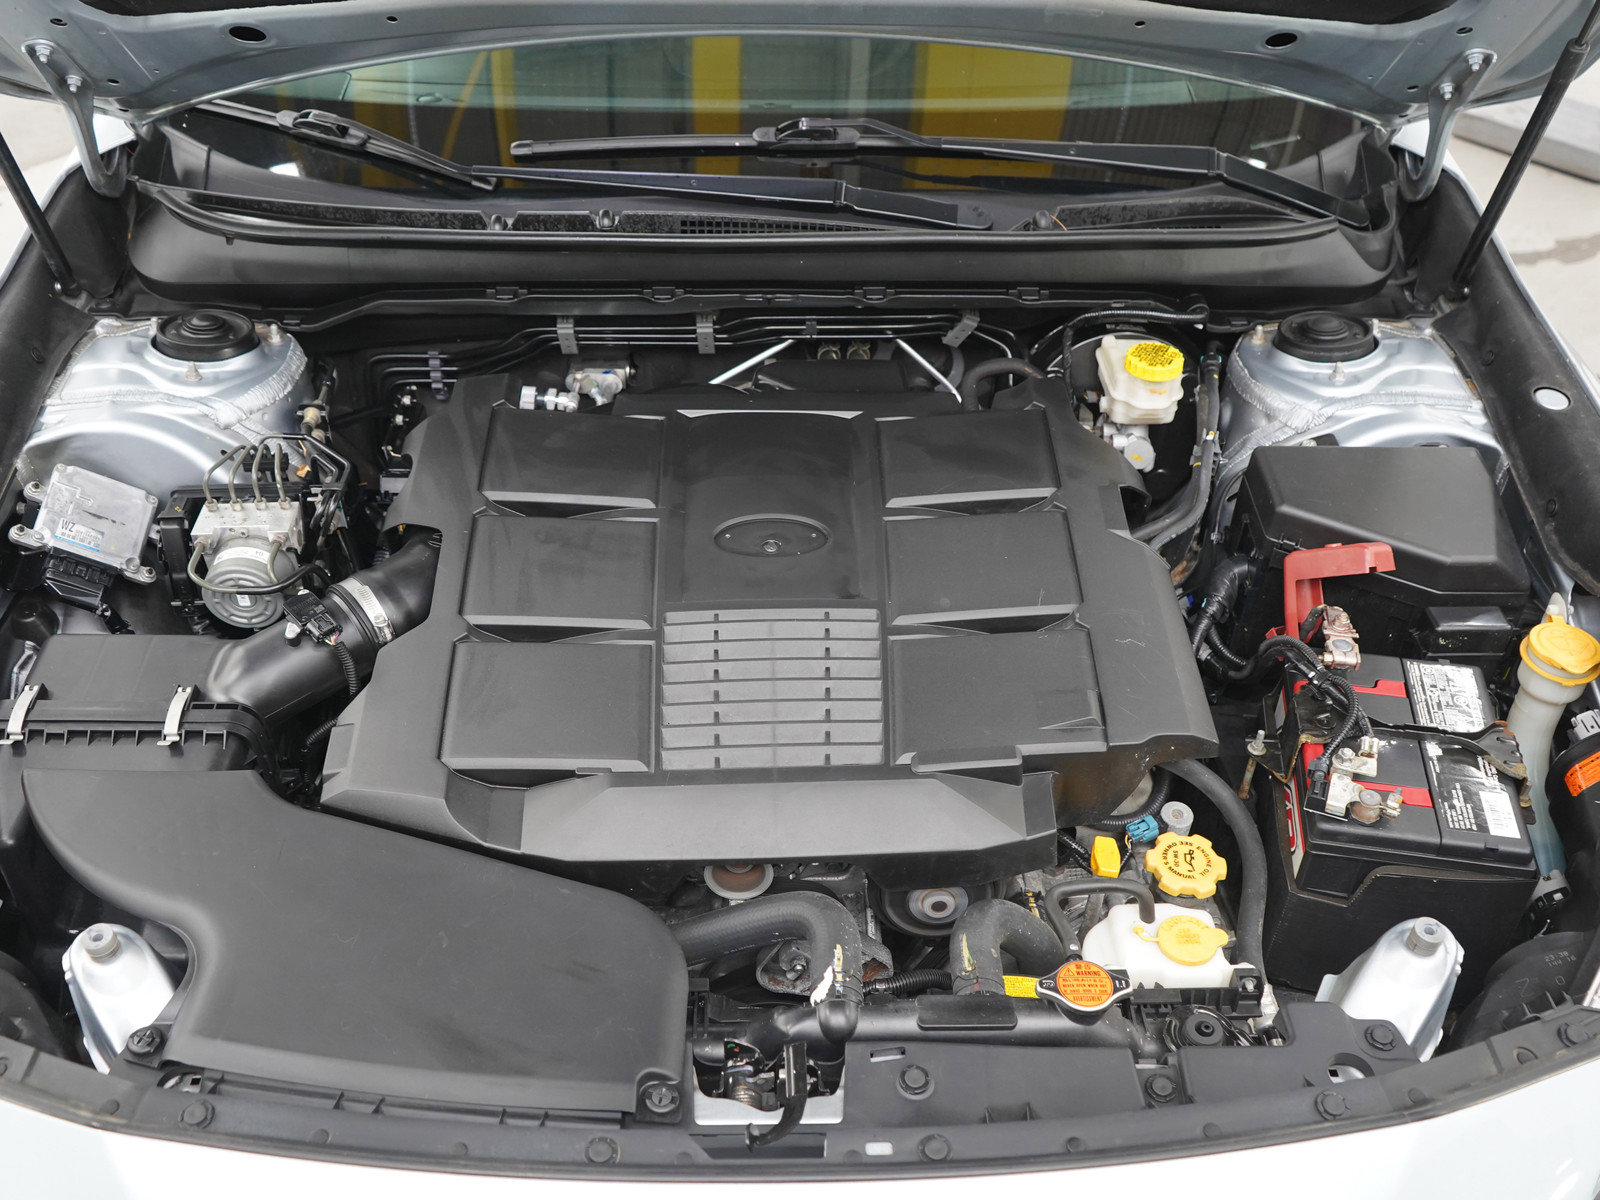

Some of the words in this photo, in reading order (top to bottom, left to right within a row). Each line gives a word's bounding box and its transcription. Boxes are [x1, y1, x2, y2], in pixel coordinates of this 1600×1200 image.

[61, 519, 76, 533] WZ
[1196, 846, 1212, 868] ENGINE
[1167, 866, 1197, 880] MANUAL
[1199, 868, 1210, 877] OIL
